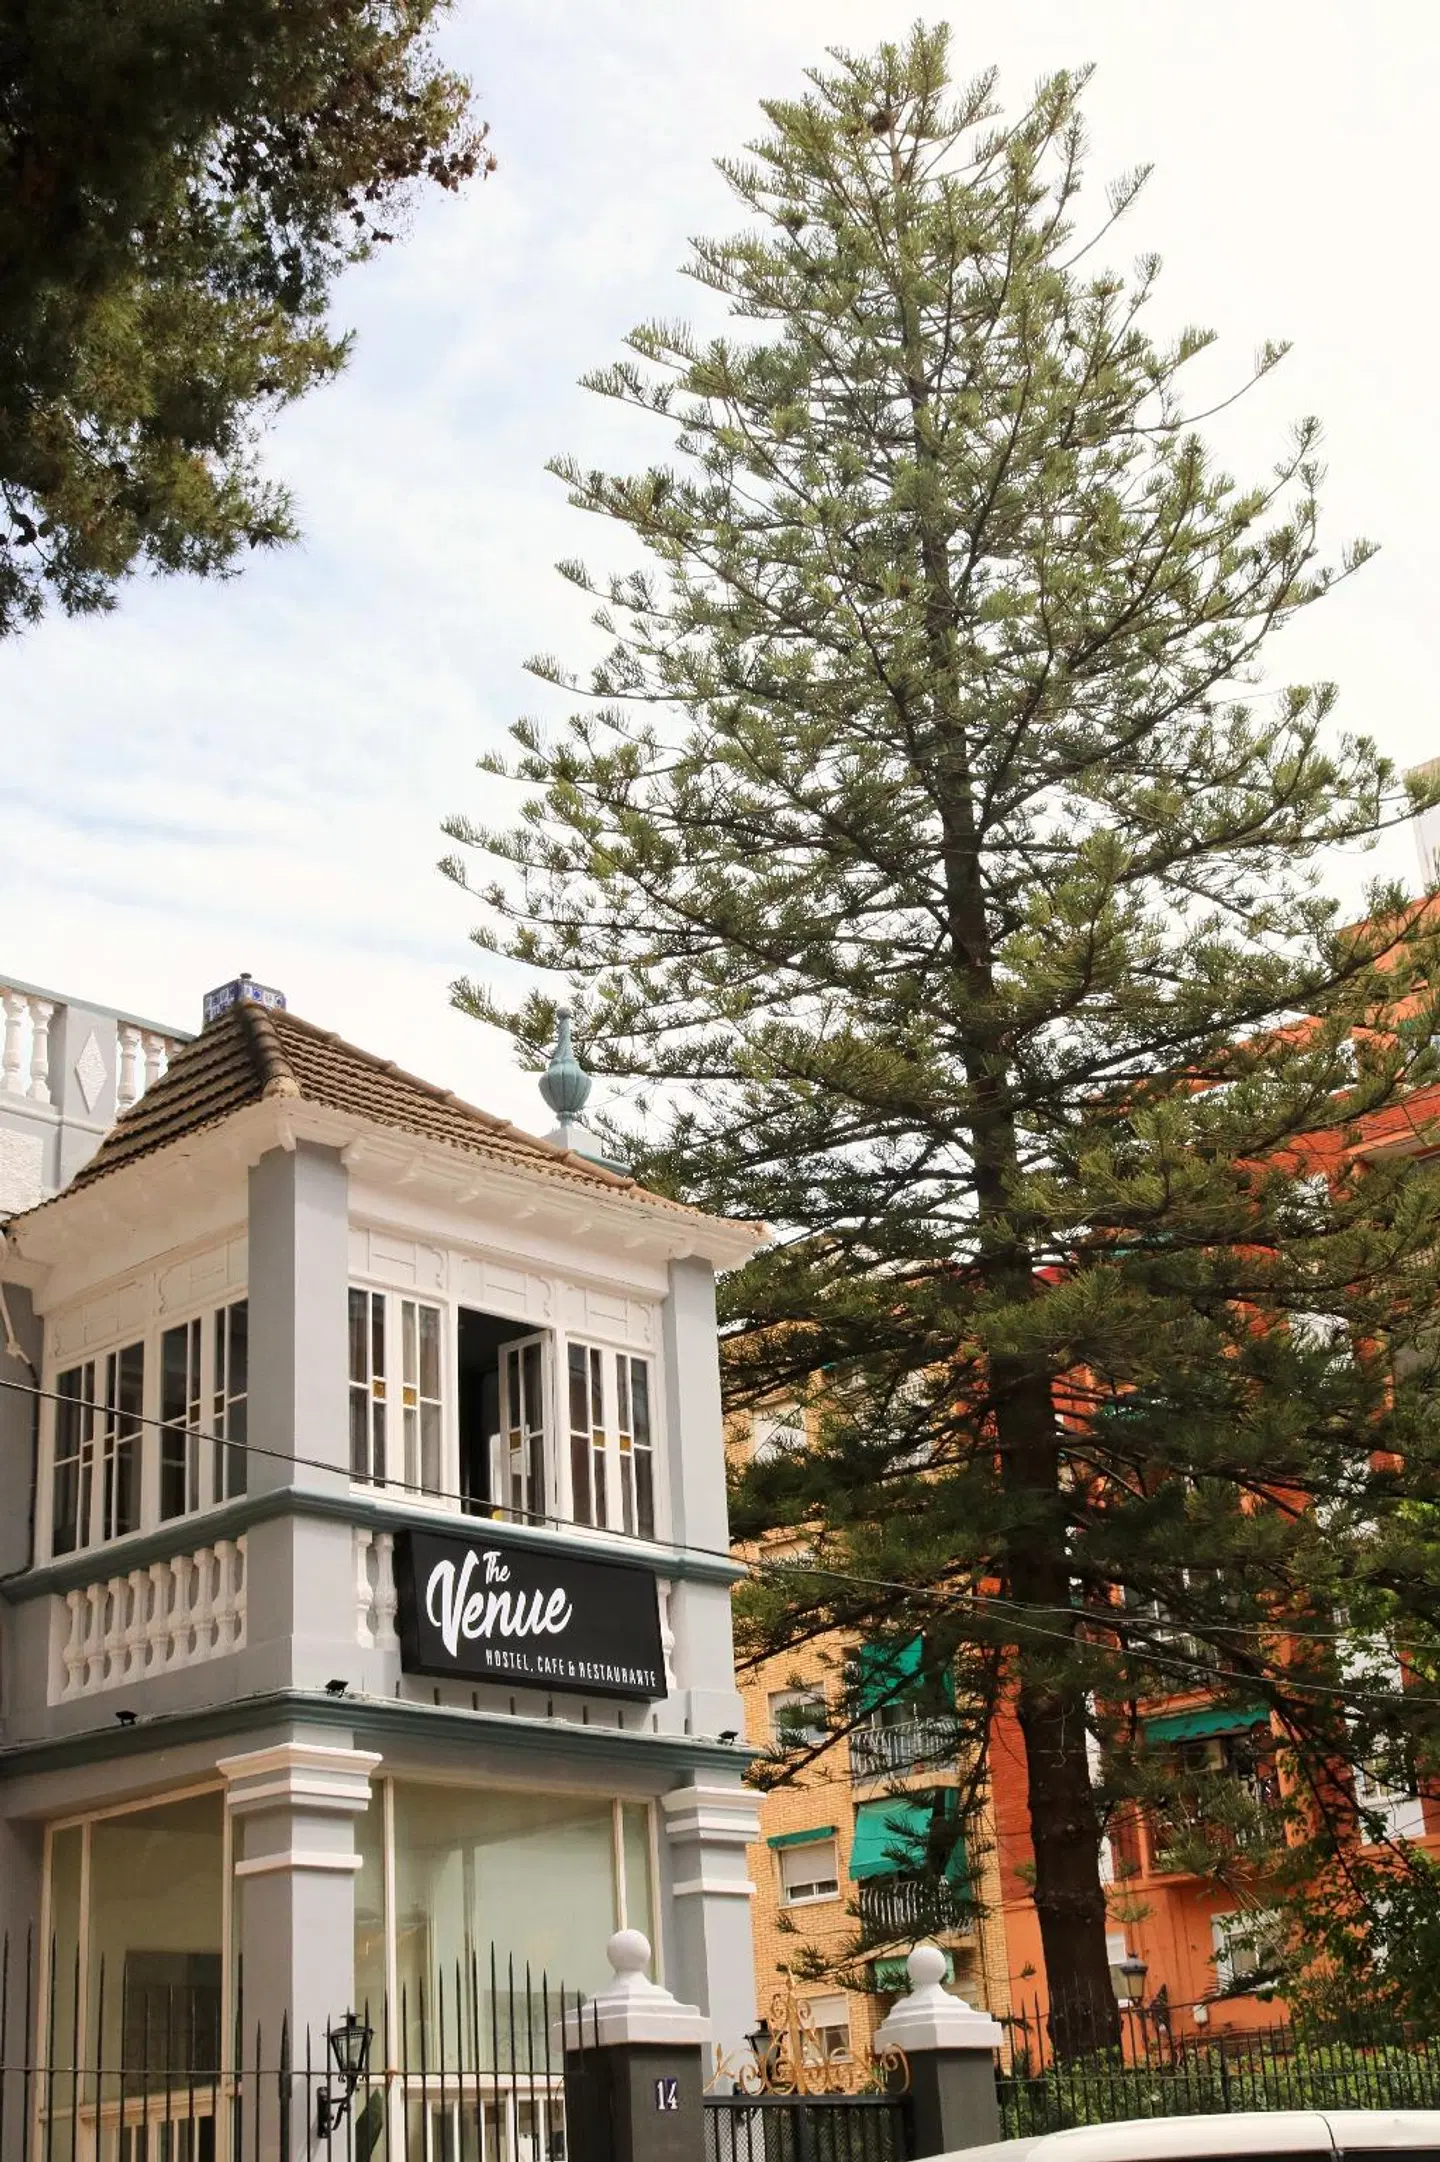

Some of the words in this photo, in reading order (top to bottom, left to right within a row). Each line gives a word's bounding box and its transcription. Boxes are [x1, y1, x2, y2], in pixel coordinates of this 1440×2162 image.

[483, 1551, 511, 1585] The
[426, 1549, 573, 1658] Venue
[537, 1655, 564, 1676] CAFE
[568, 1661, 575, 1677] &
[579, 1661, 656, 1688] RESTAURANTE
[657, 2080, 678, 2110] 14
